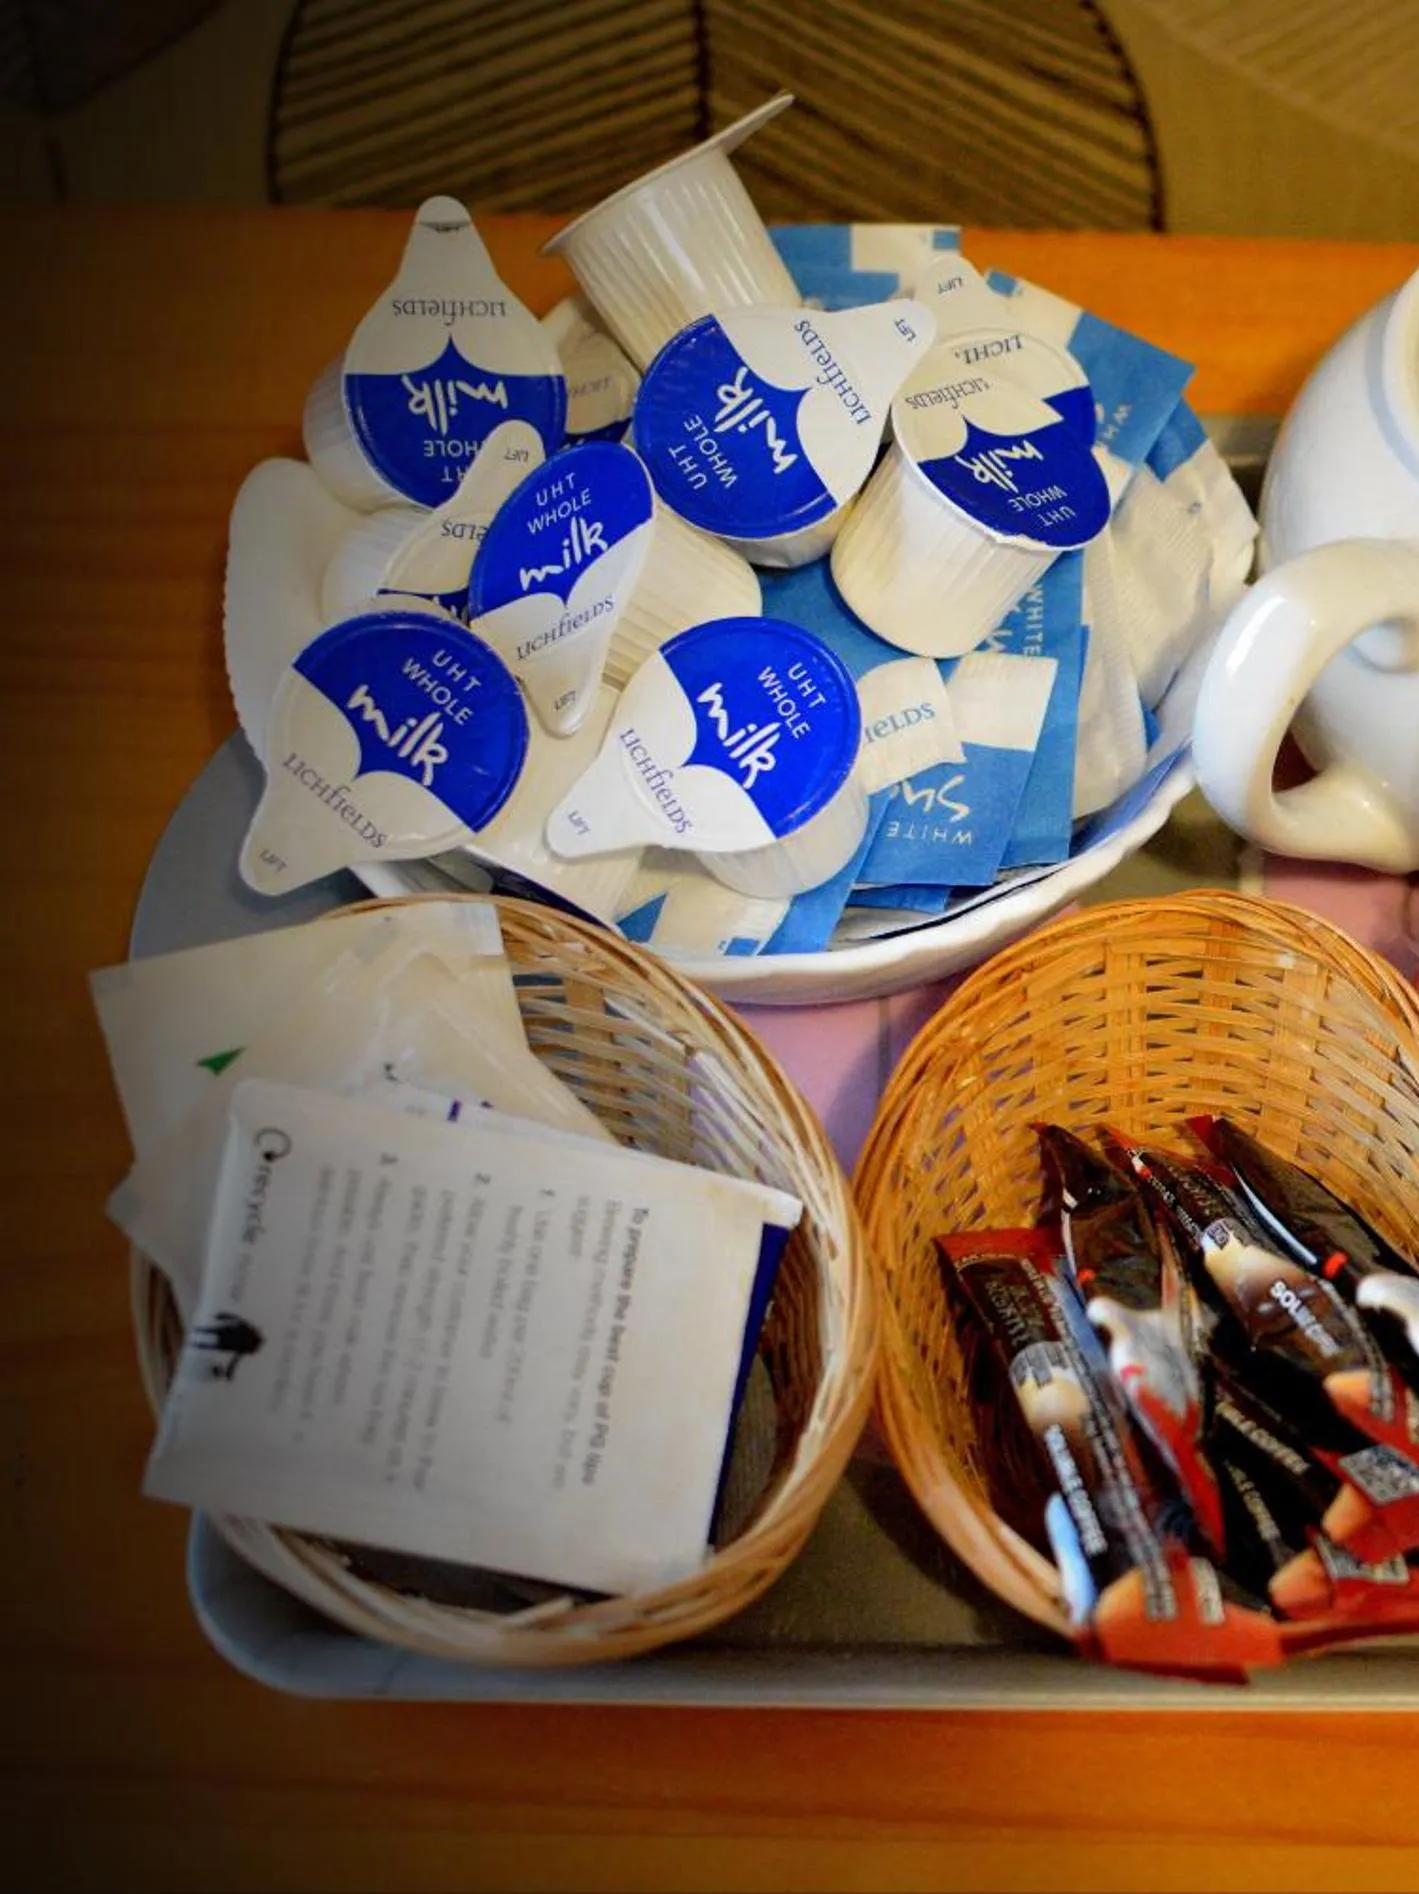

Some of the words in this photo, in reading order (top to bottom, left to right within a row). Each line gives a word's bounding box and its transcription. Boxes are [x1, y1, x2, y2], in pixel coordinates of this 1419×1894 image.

[401, 376, 507, 435] milk
[714, 367, 799, 475] milk
[423, 439, 482, 458] HOLE
[667, 446, 707, 490] UHT
[684, 415, 739, 489] WHOLE
[954, 440, 1043, 494] milk
[527, 488, 592, 536] WHOLE
[535, 473, 578, 507] UHT
[1008, 485, 1069, 511] WHOLE
[1040, 505, 1077, 528] UHT
[519, 518, 609, 591] milk
[401, 657, 476, 726] WHOLE
[431, 649, 482, 693] UHT
[787, 662, 827, 709] UHT
[757, 666, 811, 739] WHOLE
[345, 684, 450, 788] milk
[695, 683, 778, 790] milk
[568, 811, 591, 836] LIFT
[884, 820, 972, 848] WHITE
[238, 1161, 274, 1248] recycle
[630, 1205, 649, 1225] To
[616, 1225, 643, 1291] prepare
[611, 1292, 632, 1321] the
[604, 1323, 627, 1362] best
[595, 1363, 617, 1398] cup
[593, 1400, 613, 1420] of
